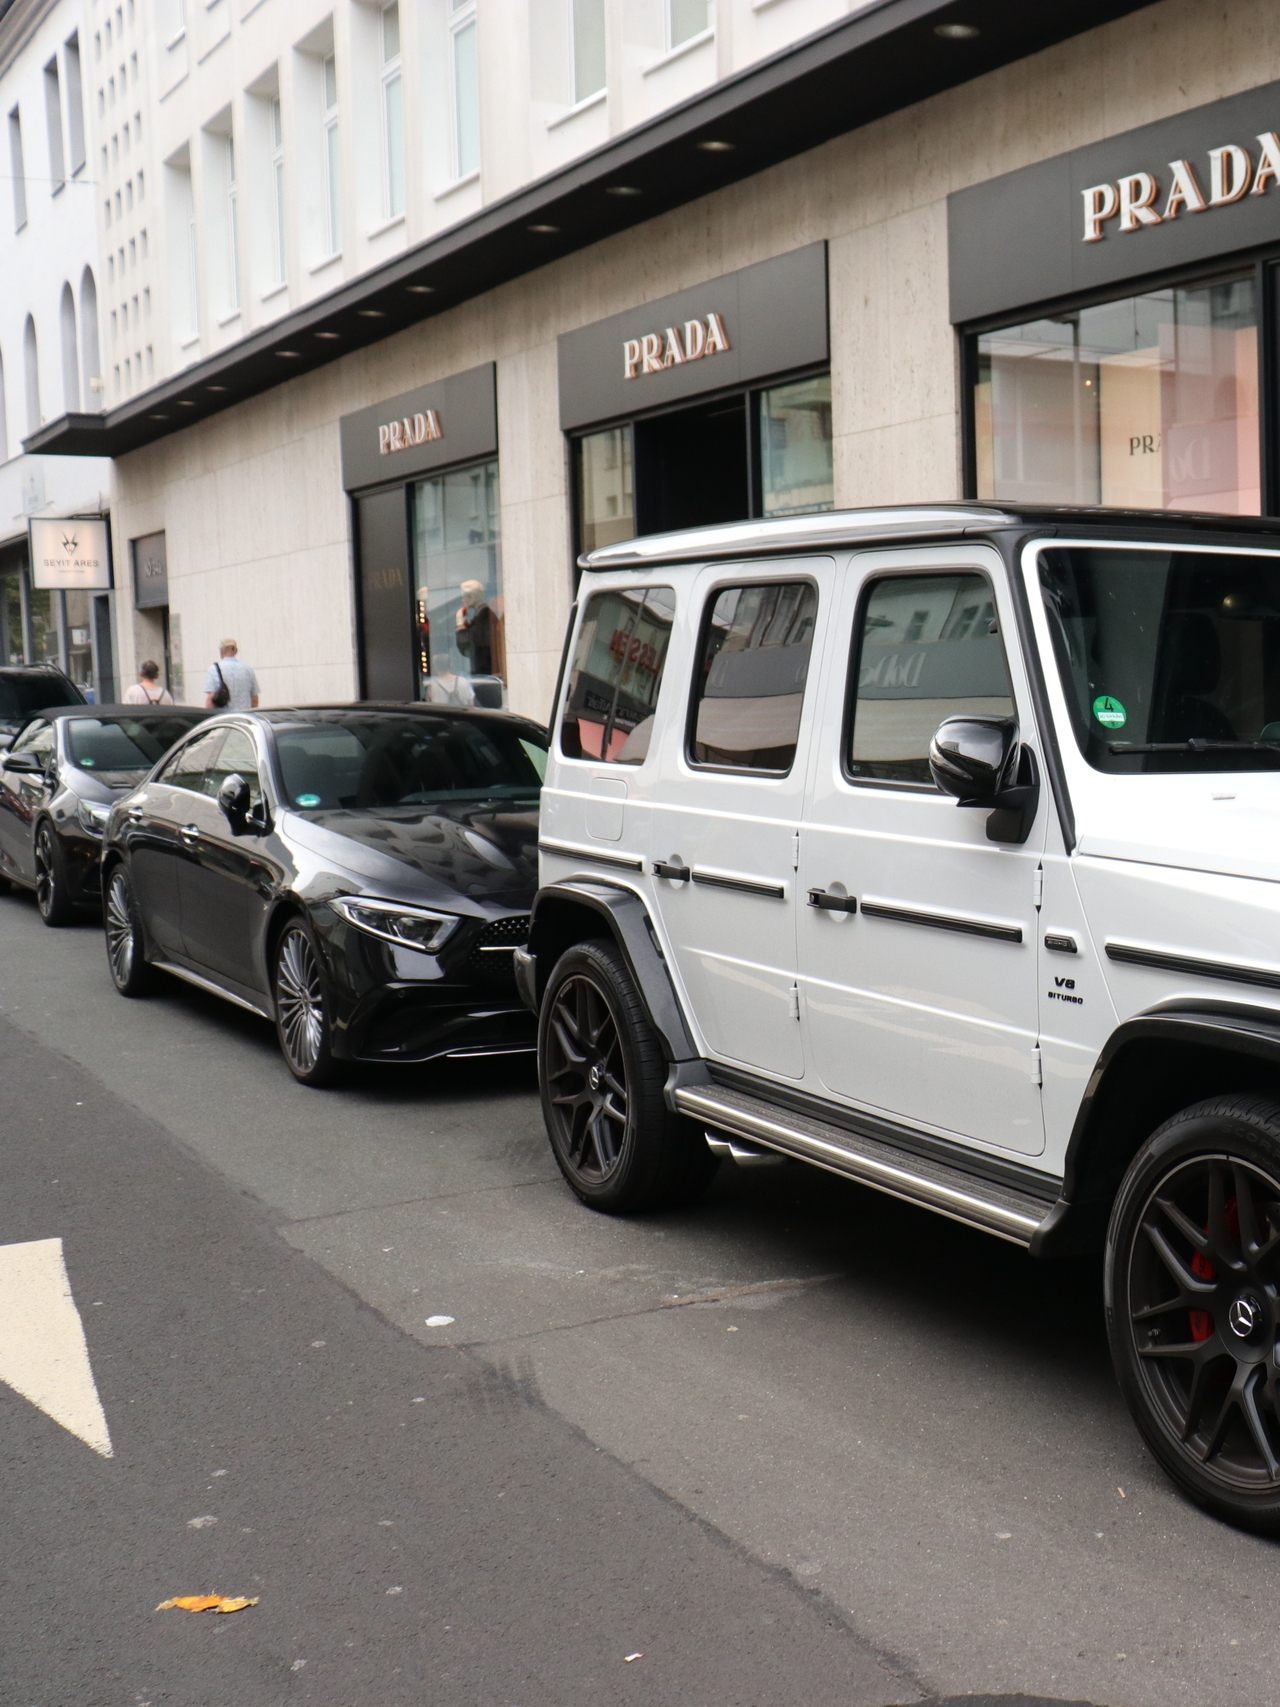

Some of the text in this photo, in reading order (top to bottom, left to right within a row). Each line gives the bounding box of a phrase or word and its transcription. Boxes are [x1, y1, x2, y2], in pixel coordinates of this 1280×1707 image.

[622, 312, 732, 379] PRADA
[378, 409, 443, 455] PRADA
[43, 558, 99, 568] SEYIT ARES
[1104, 697, 1114, 712] 4
[1054, 976, 1075, 989] V8
[1047, 991, 1083, 1005] BITURBO
